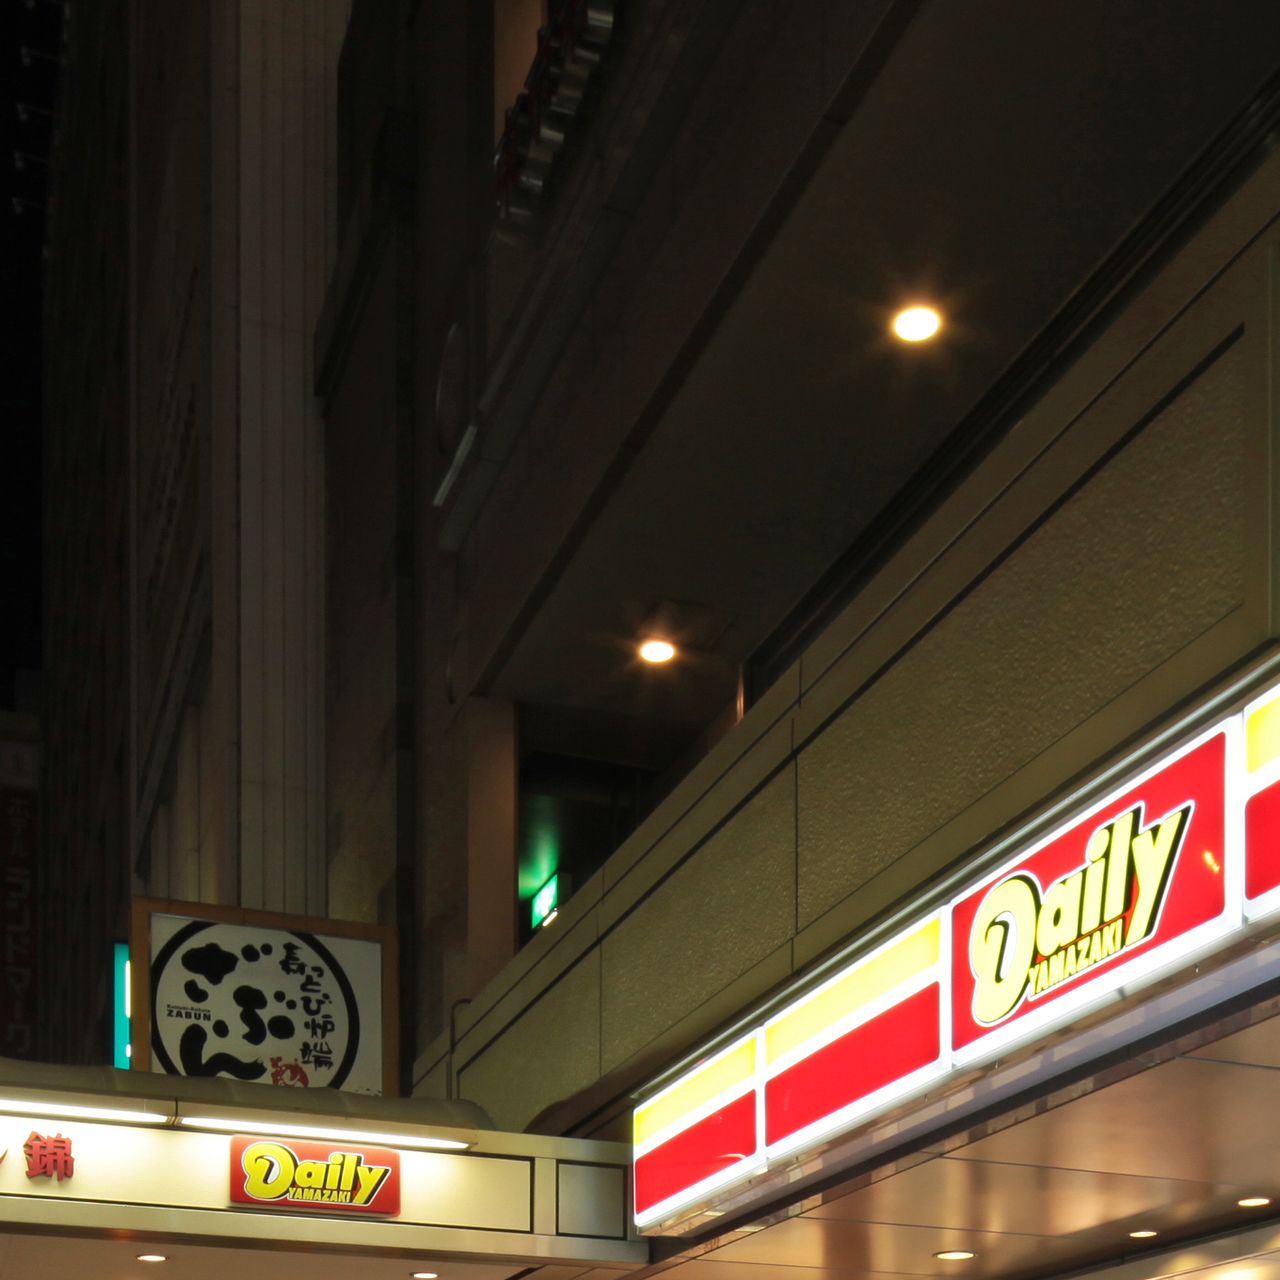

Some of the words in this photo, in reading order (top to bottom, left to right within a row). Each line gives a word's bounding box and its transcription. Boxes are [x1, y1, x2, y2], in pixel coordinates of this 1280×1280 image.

[970, 802, 1192, 1024] Daily
[1029, 918, 1124, 996] YAMAZAKI
[166, 1009, 211, 1022] ZABUN
[242, 1141, 391, 1207] Daily
[287, 1186, 352, 1204] YAMAZAKI
